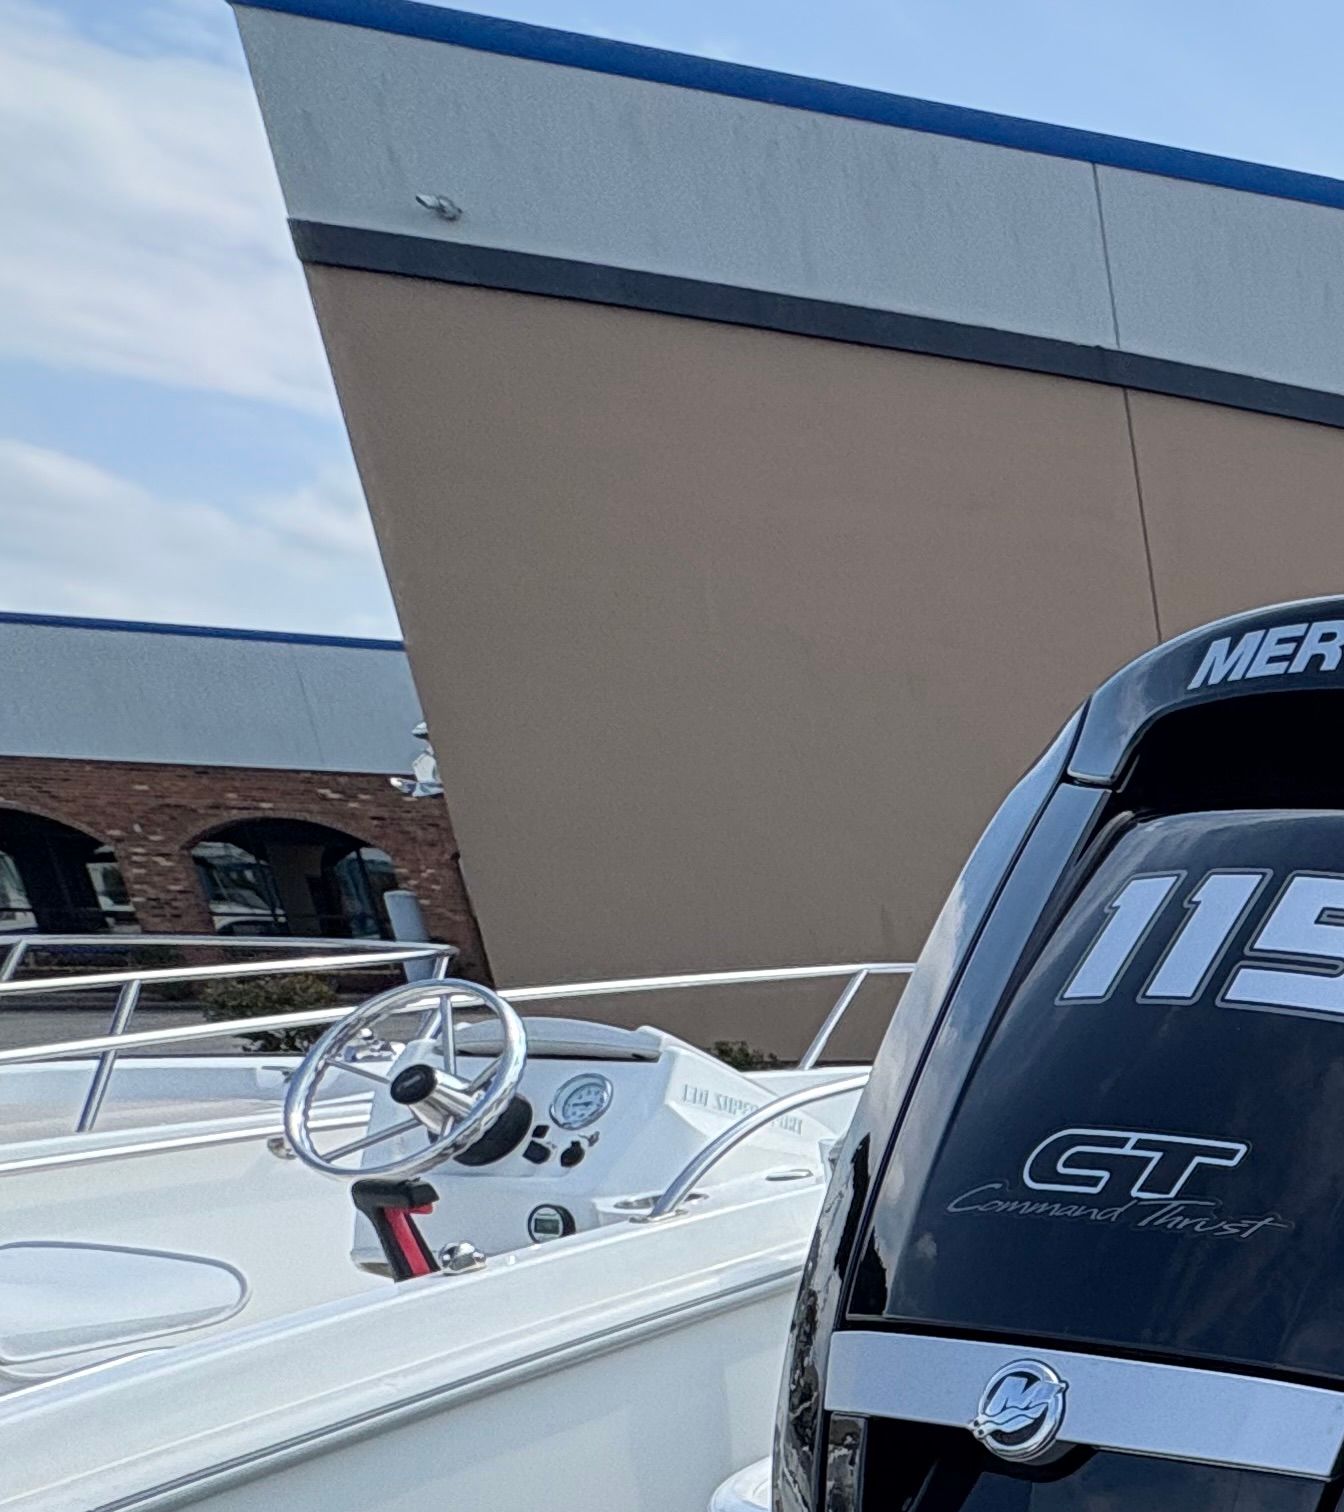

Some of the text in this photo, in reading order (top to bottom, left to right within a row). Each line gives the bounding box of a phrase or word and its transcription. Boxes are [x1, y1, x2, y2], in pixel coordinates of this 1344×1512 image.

[1022, 1126, 1252, 1200] GT
[945, 1181, 1296, 1239] Command Thrust
